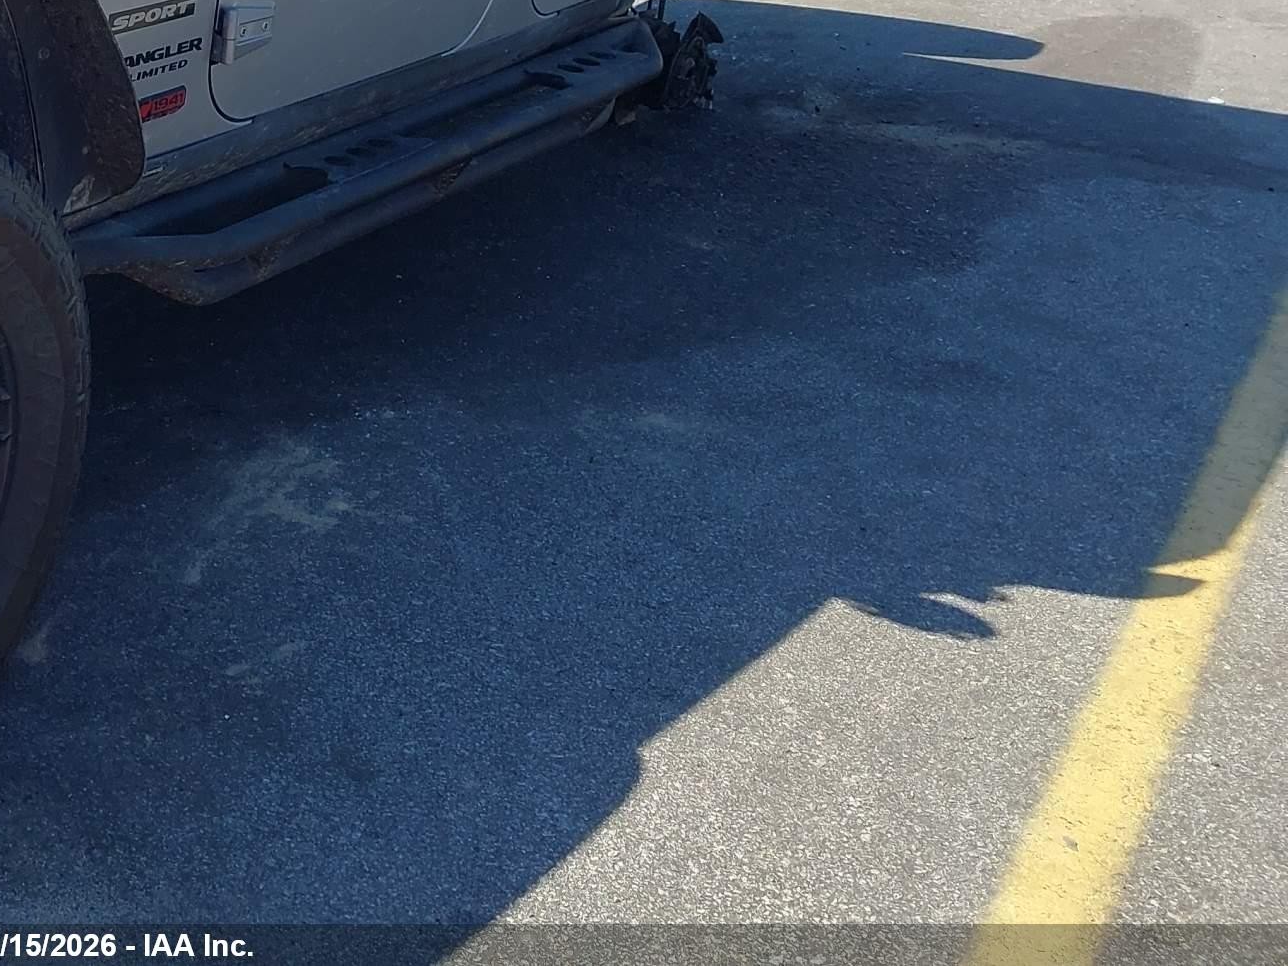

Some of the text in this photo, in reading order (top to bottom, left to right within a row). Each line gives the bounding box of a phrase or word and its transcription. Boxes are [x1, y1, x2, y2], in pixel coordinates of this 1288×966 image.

[112, 0, 196, 31] SPORT
[123, 37, 203, 67] ANGLER
[130, 59, 188, 82] LIMITED
